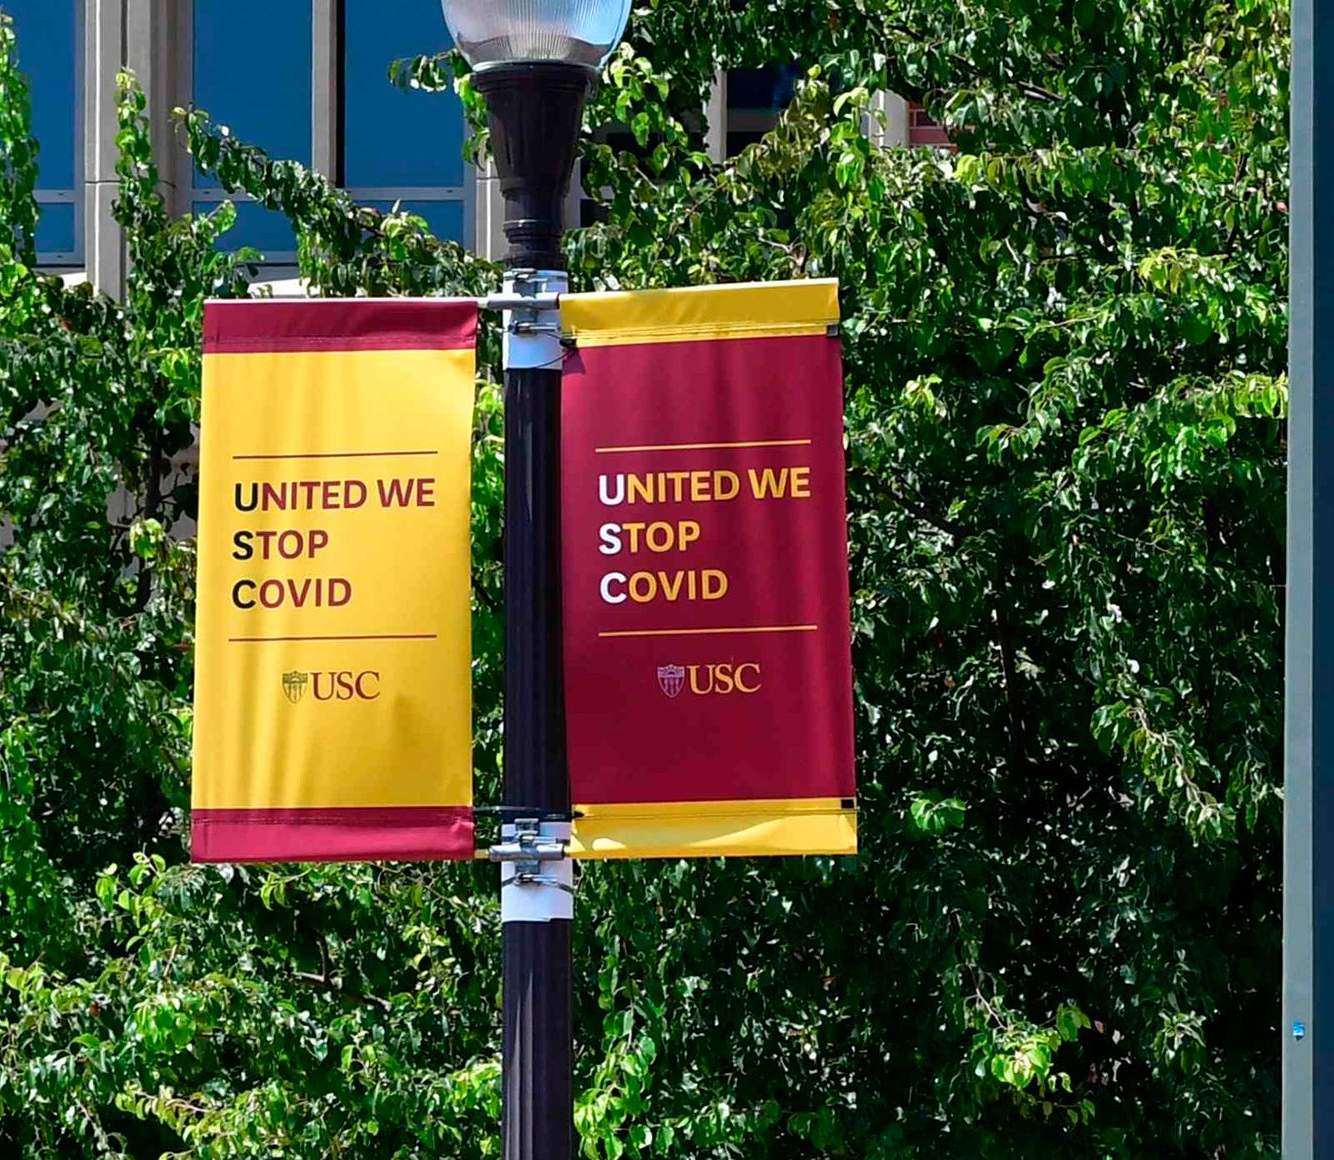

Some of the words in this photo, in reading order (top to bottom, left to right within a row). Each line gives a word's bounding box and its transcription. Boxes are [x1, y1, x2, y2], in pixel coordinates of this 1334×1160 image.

[234, 480, 367, 512] UNITED
[376, 478, 436, 508] WE
[598, 470, 740, 506] UNITED
[747, 466, 811, 499] WE
[232, 529, 329, 561] STOP
[598, 521, 700, 555] STOP
[232, 578, 352, 609] COVID
[599, 569, 728, 604] COVID
[311, 670, 380, 701] USC
[689, 663, 761, 694] USC
